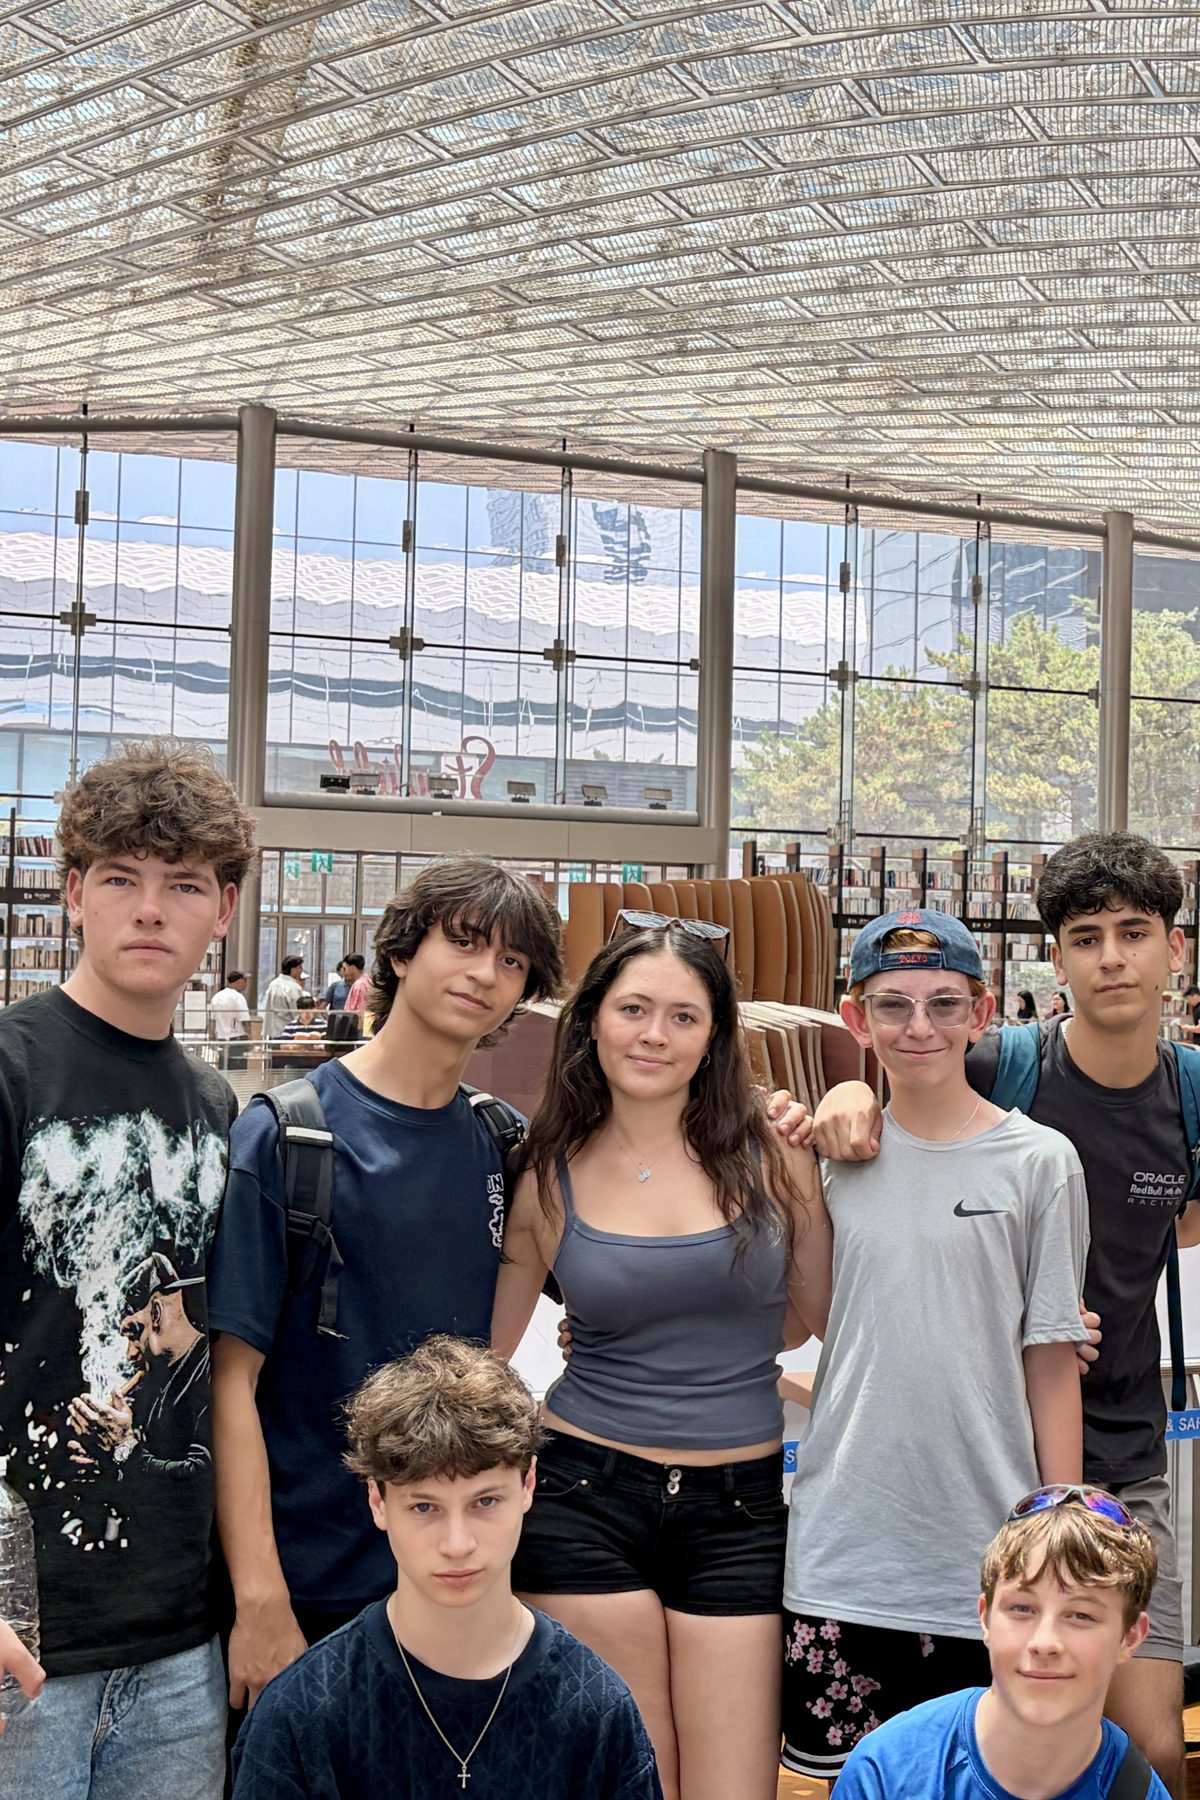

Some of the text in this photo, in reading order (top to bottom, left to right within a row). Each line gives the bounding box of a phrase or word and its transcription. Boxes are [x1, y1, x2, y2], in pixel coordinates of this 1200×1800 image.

[1133, 1171, 1187, 1184] ORACLE
[1130, 1183, 1163, 1196] Red Bull
